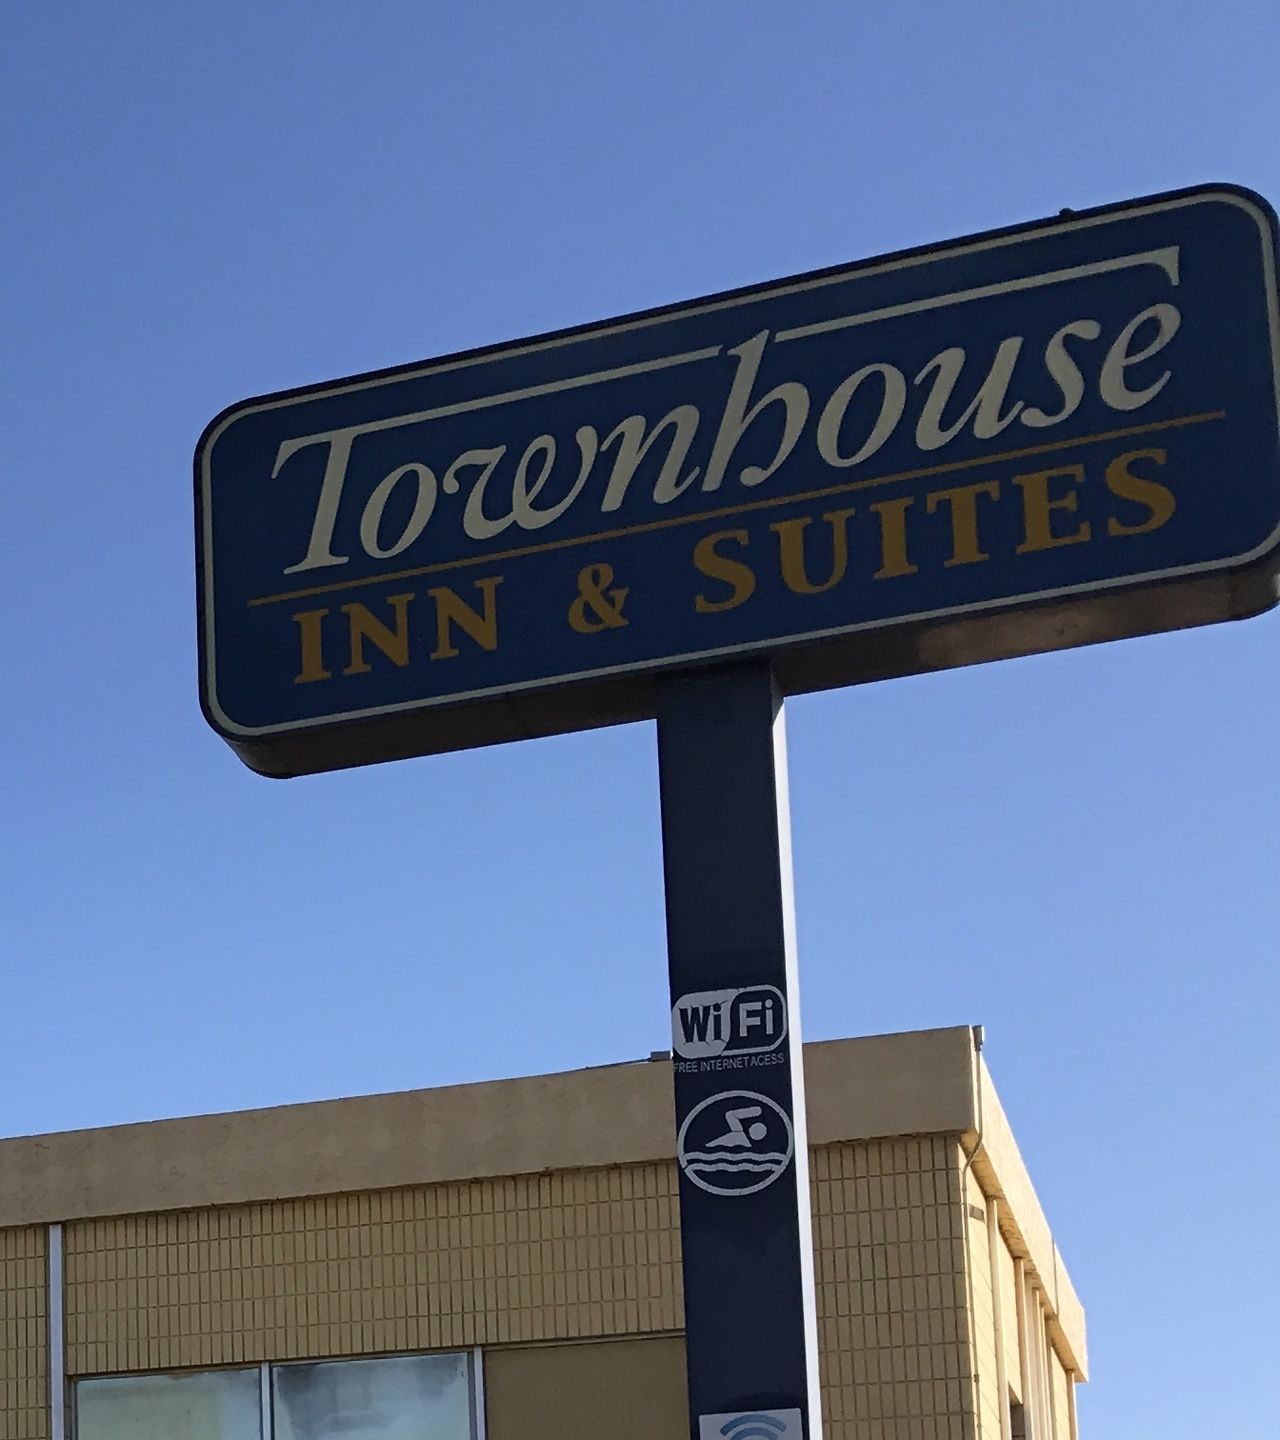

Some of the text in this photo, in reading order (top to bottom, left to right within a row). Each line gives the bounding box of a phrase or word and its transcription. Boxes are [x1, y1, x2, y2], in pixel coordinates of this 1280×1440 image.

[271, 246, 1181, 574] Townhouse
[292, 447, 1178, 685] INN & SUITES
[700, 1057, 750, 1072] INTERNET
